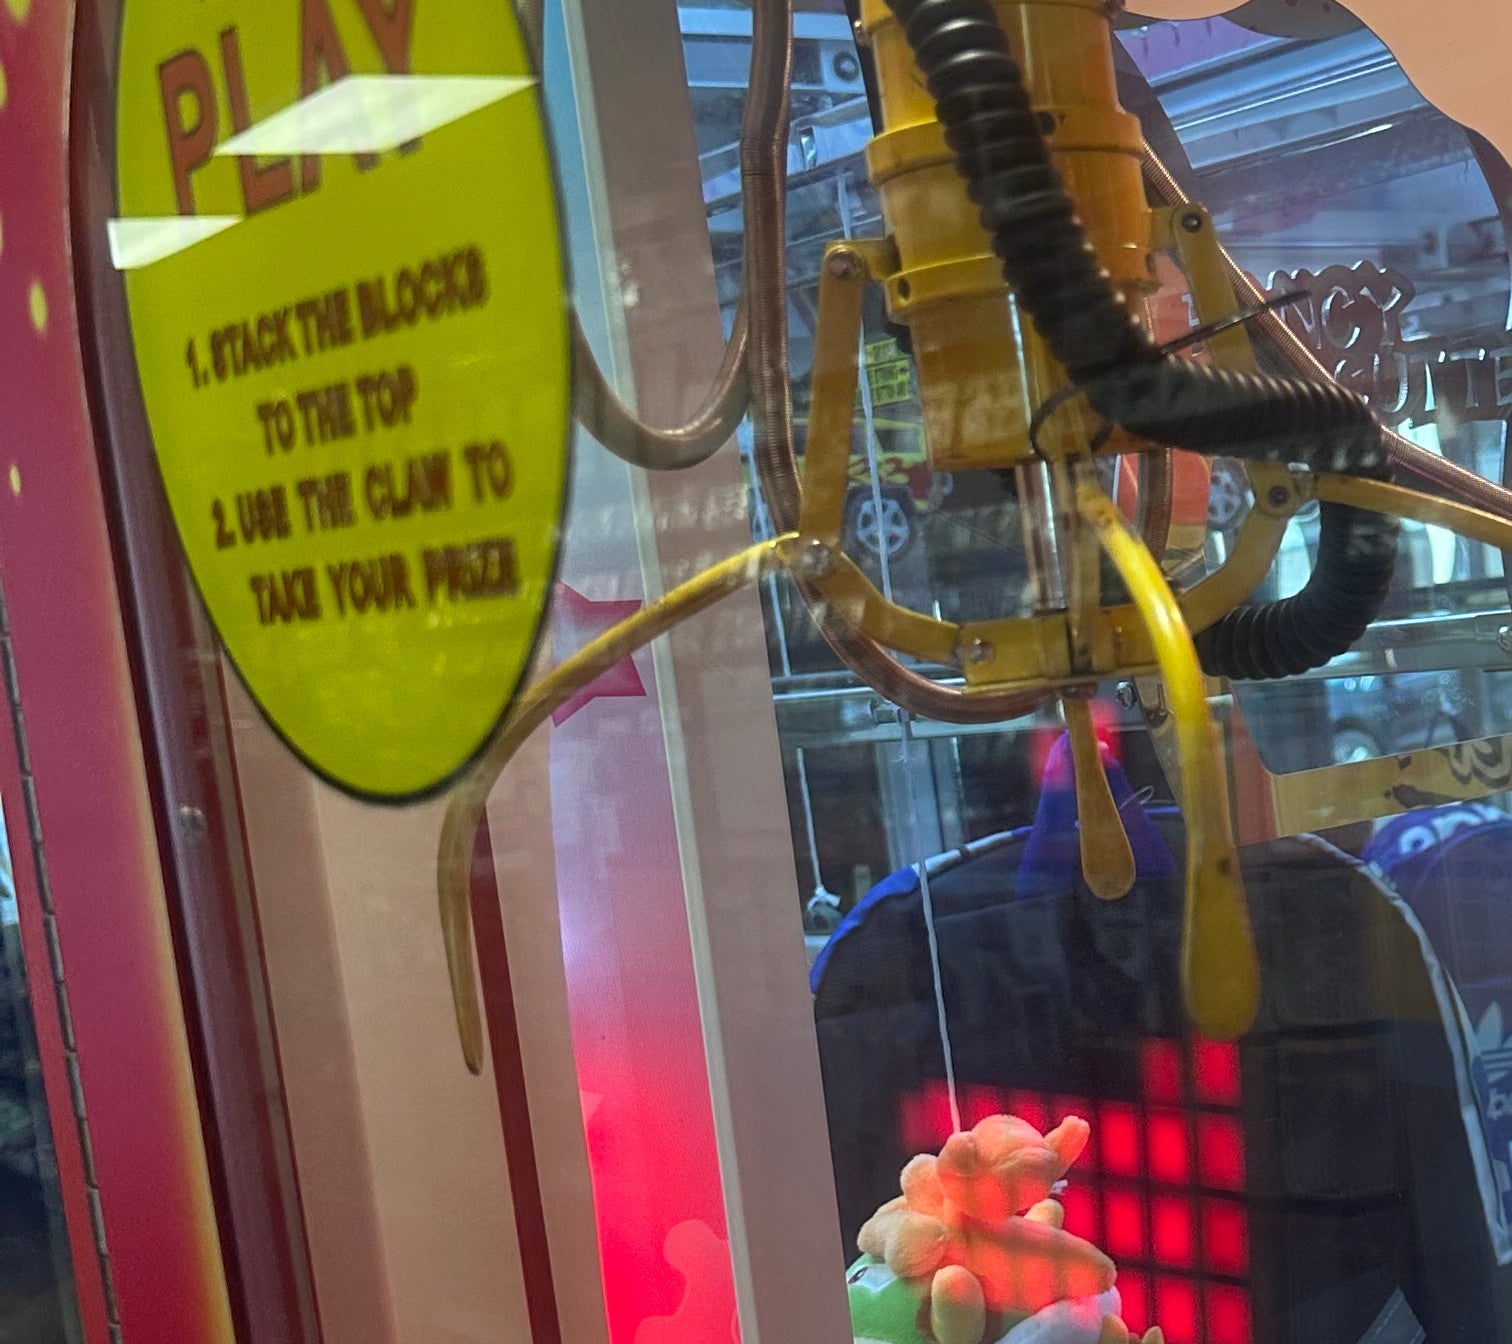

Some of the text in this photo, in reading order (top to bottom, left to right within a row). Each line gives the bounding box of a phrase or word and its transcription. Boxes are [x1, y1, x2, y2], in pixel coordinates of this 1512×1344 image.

[186, 244, 489, 389] 1. STACK THE BLOCKS
[1280, 284, 1402, 350] NCY
[256, 365, 418, 457] TO THE TOP
[237, 485, 292, 545] USE
[298, 470, 356, 533] THE
[365, 450, 453, 522] CLAW
[464, 441, 514, 503] TO
[251, 536, 520, 626] TAKE YOUR PRIZE
